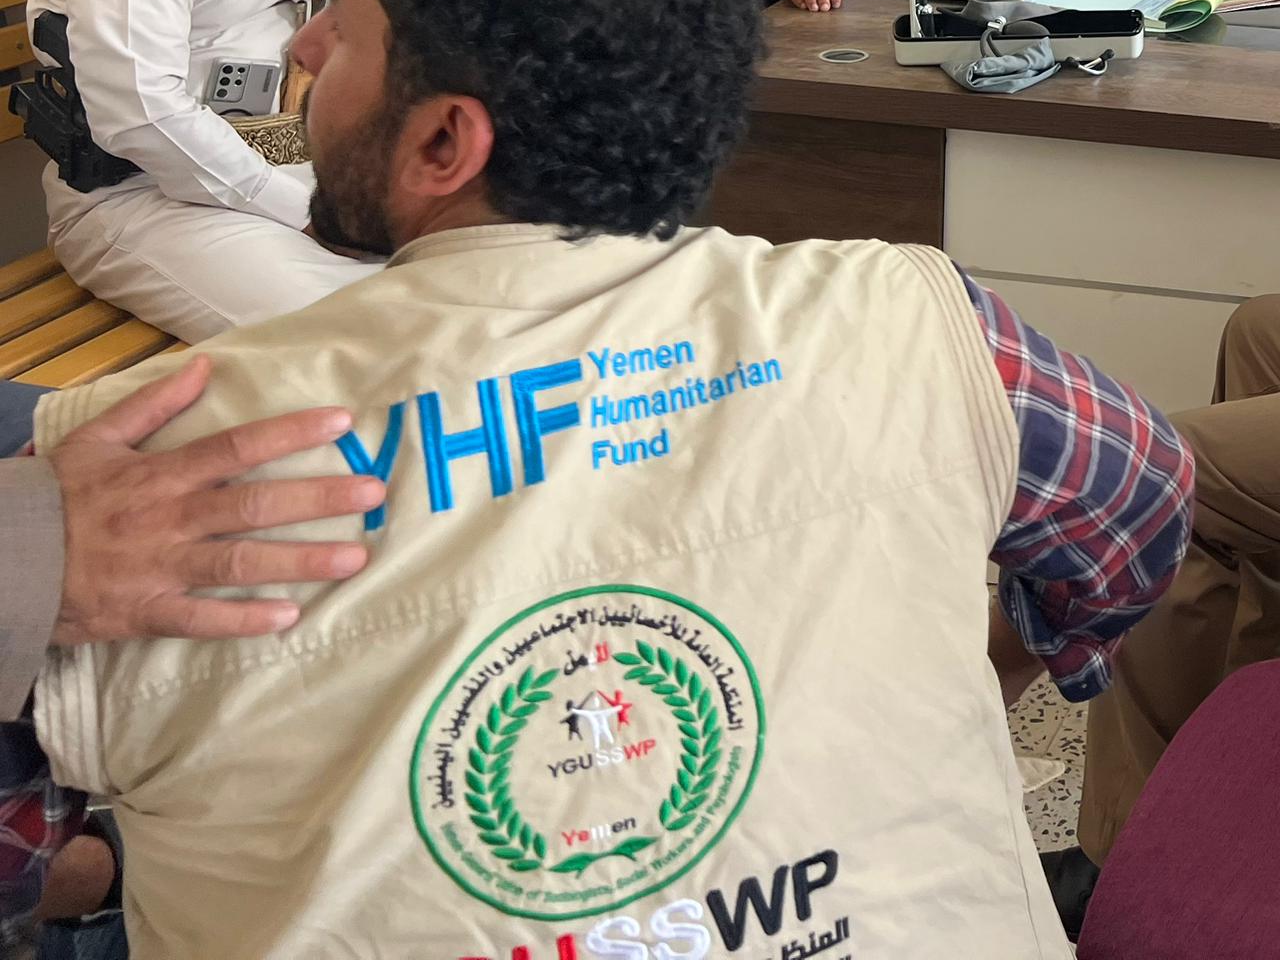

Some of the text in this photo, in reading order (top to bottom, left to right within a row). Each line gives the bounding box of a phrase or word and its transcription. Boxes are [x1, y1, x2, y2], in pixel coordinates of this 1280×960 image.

[587, 339, 695, 380] Yemen
[590, 354, 783, 430] Humanitarian
[334, 358, 583, 532] YHF
[591, 429, 671, 470] Fund
[547, 738, 657, 779] YGUSSWP
[561, 816, 637, 847] Yemen
